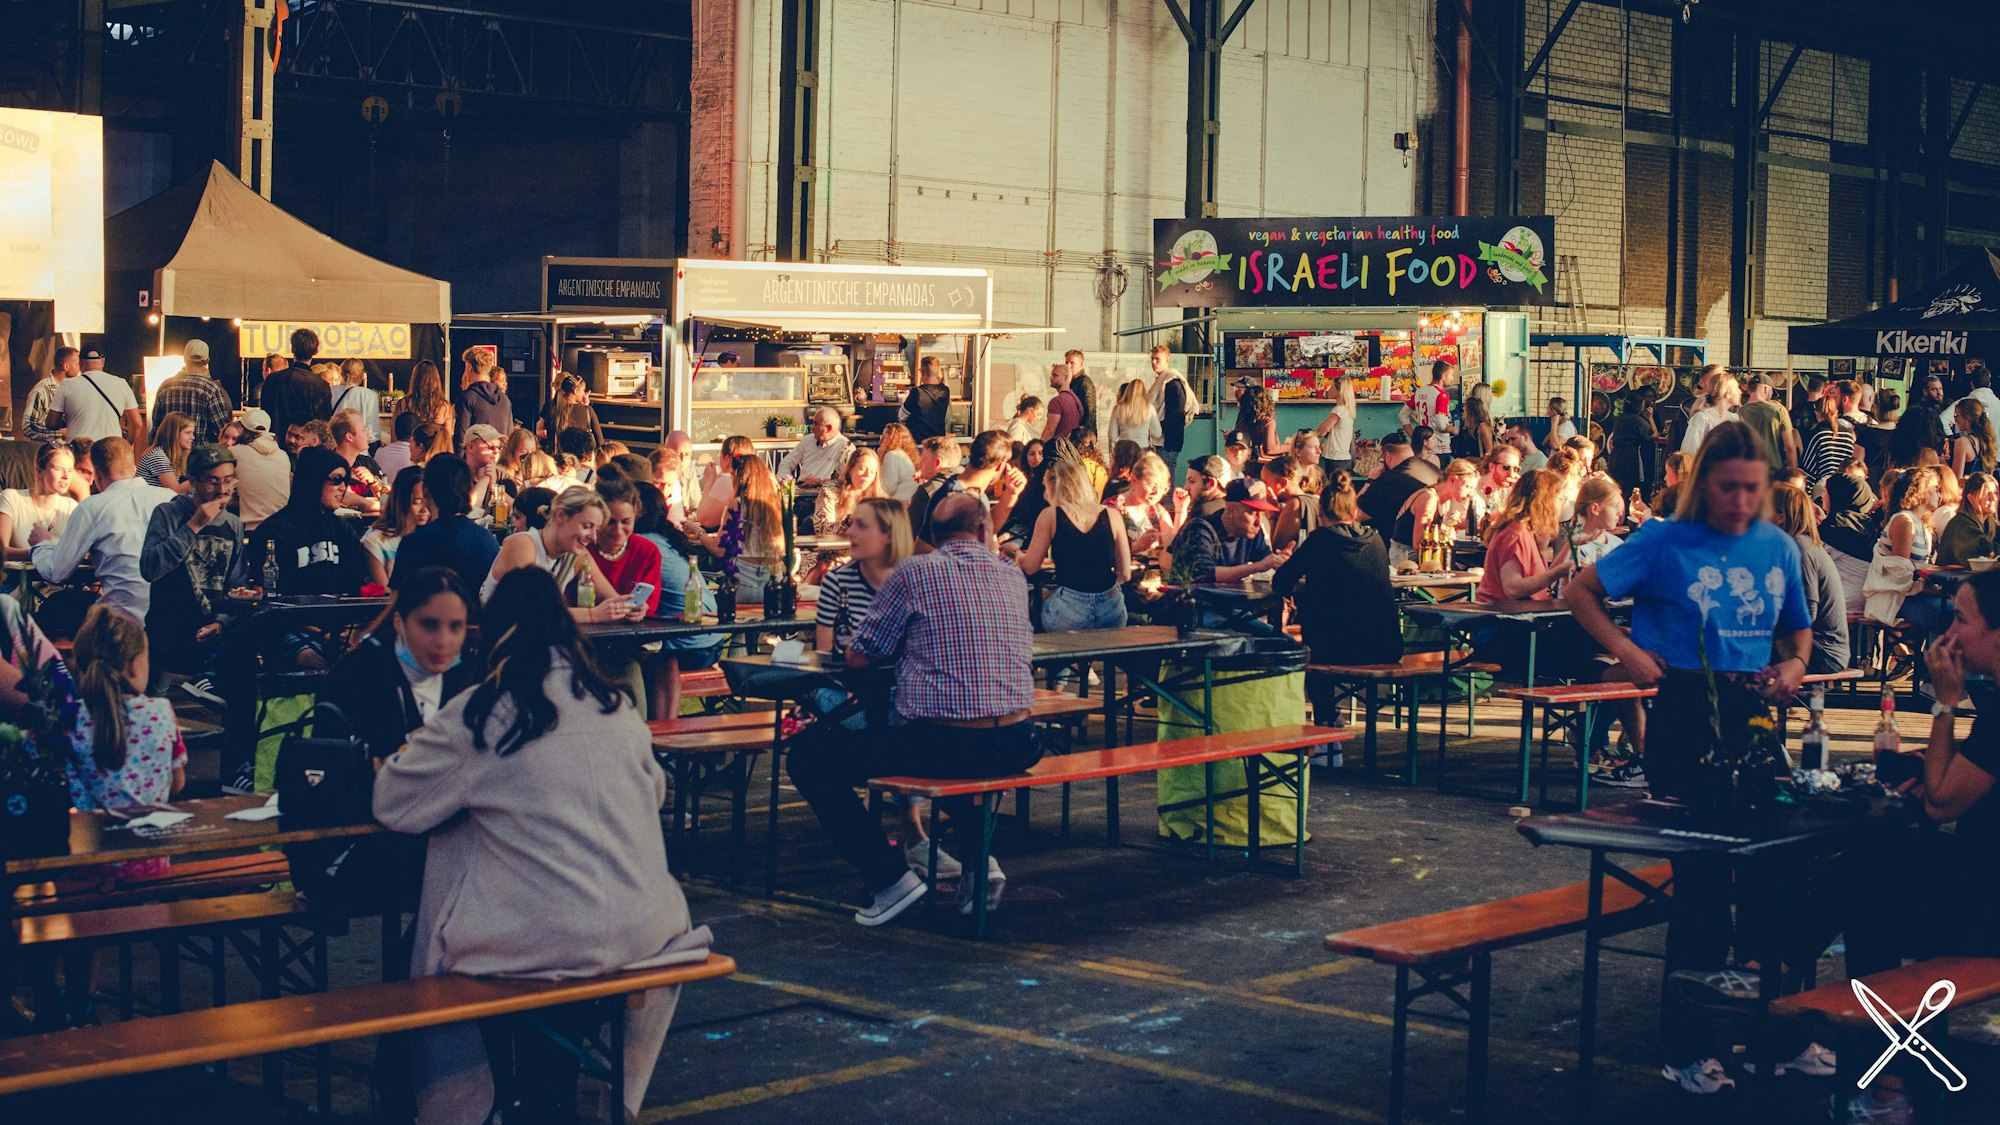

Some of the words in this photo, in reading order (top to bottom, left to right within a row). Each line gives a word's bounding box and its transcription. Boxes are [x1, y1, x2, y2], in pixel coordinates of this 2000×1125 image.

[1248, 230, 1286, 247] vegan
[1290, 227, 1301, 241] &
[1305, 225, 1373, 247] vegetarian
[1377, 225, 1426, 246] healthy
[1431, 224, 1460, 245] food
[1238, 250, 1369, 294] ISRAELI
[558, 279, 614, 298] ARGENTINISCHE
[616, 280, 661, 299] EMPANADAS
[763, 279, 860, 306] ARGENTINISCHE
[866, 281, 935, 307] EMPANADAS
[1876, 330, 1969, 354] Kikeriki
